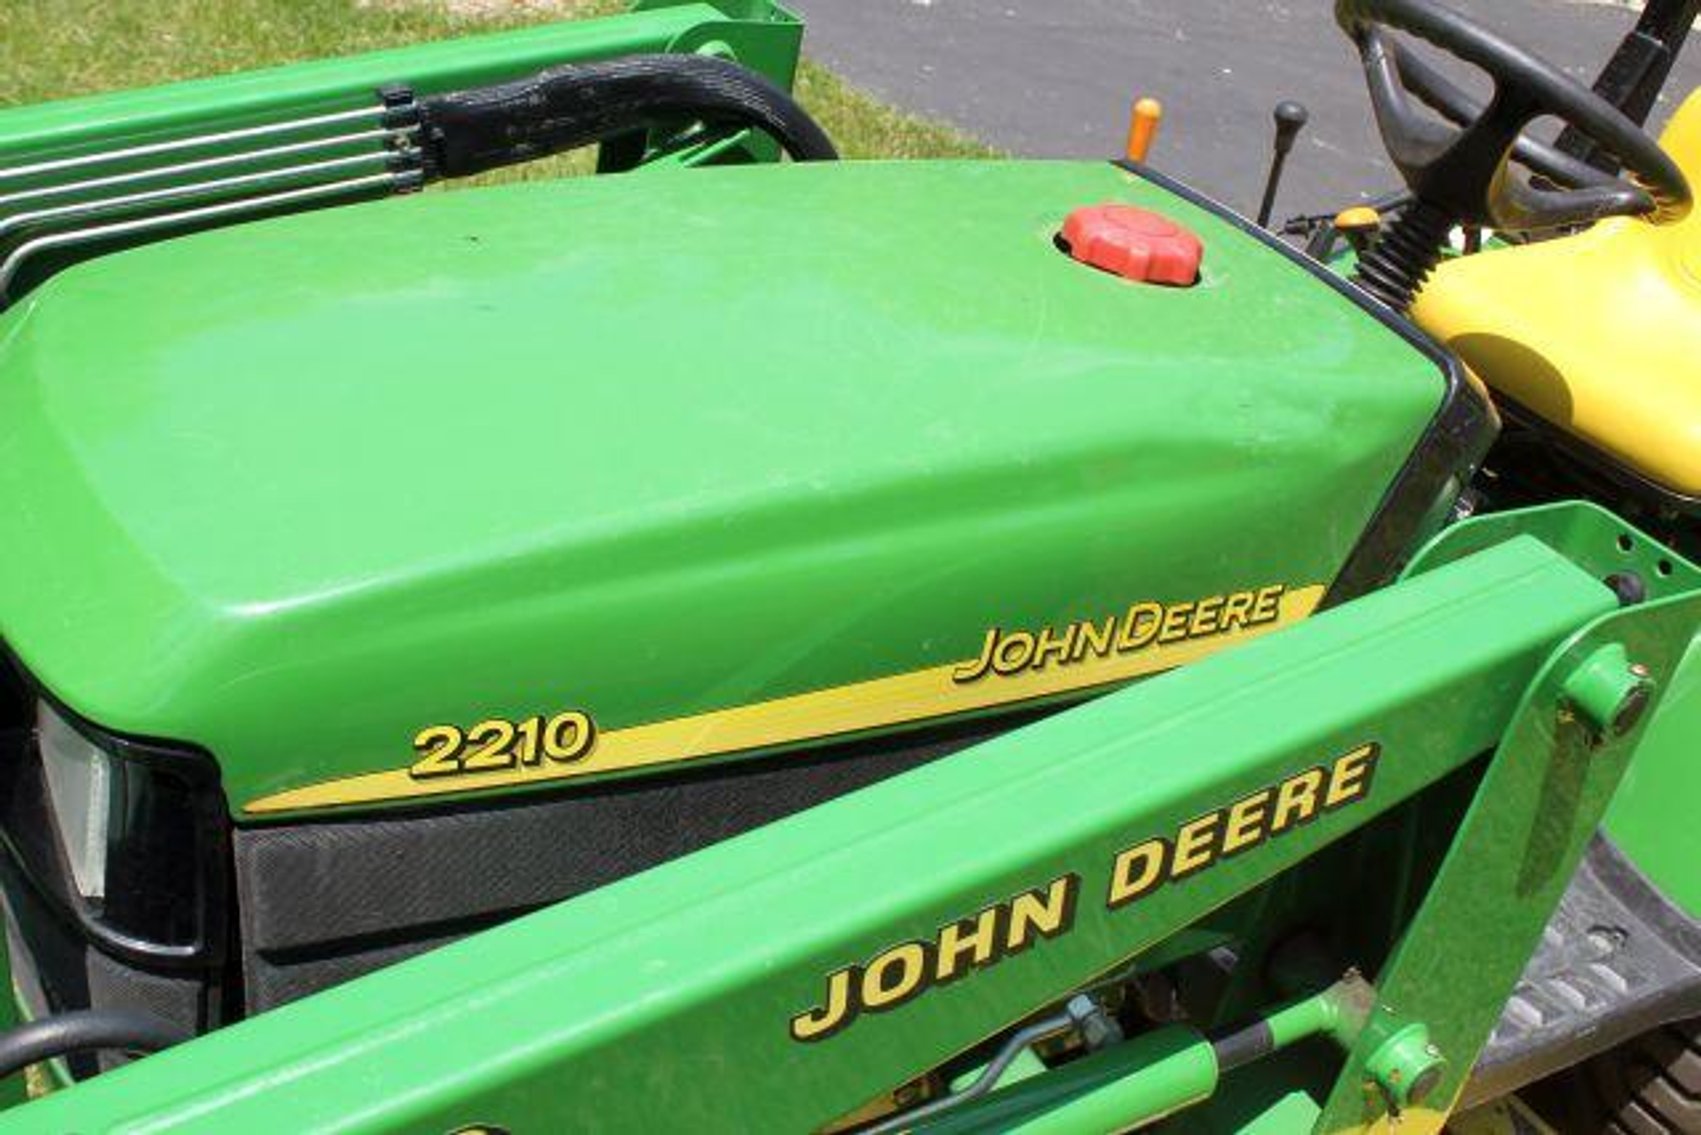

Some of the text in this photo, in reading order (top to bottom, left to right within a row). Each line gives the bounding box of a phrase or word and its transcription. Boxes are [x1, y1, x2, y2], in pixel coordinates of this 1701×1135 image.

[953, 585, 1284, 683] JOHN DEERE
[410, 711, 597, 781] 2210
[790, 742, 1380, 1042] JOHN DEERE
